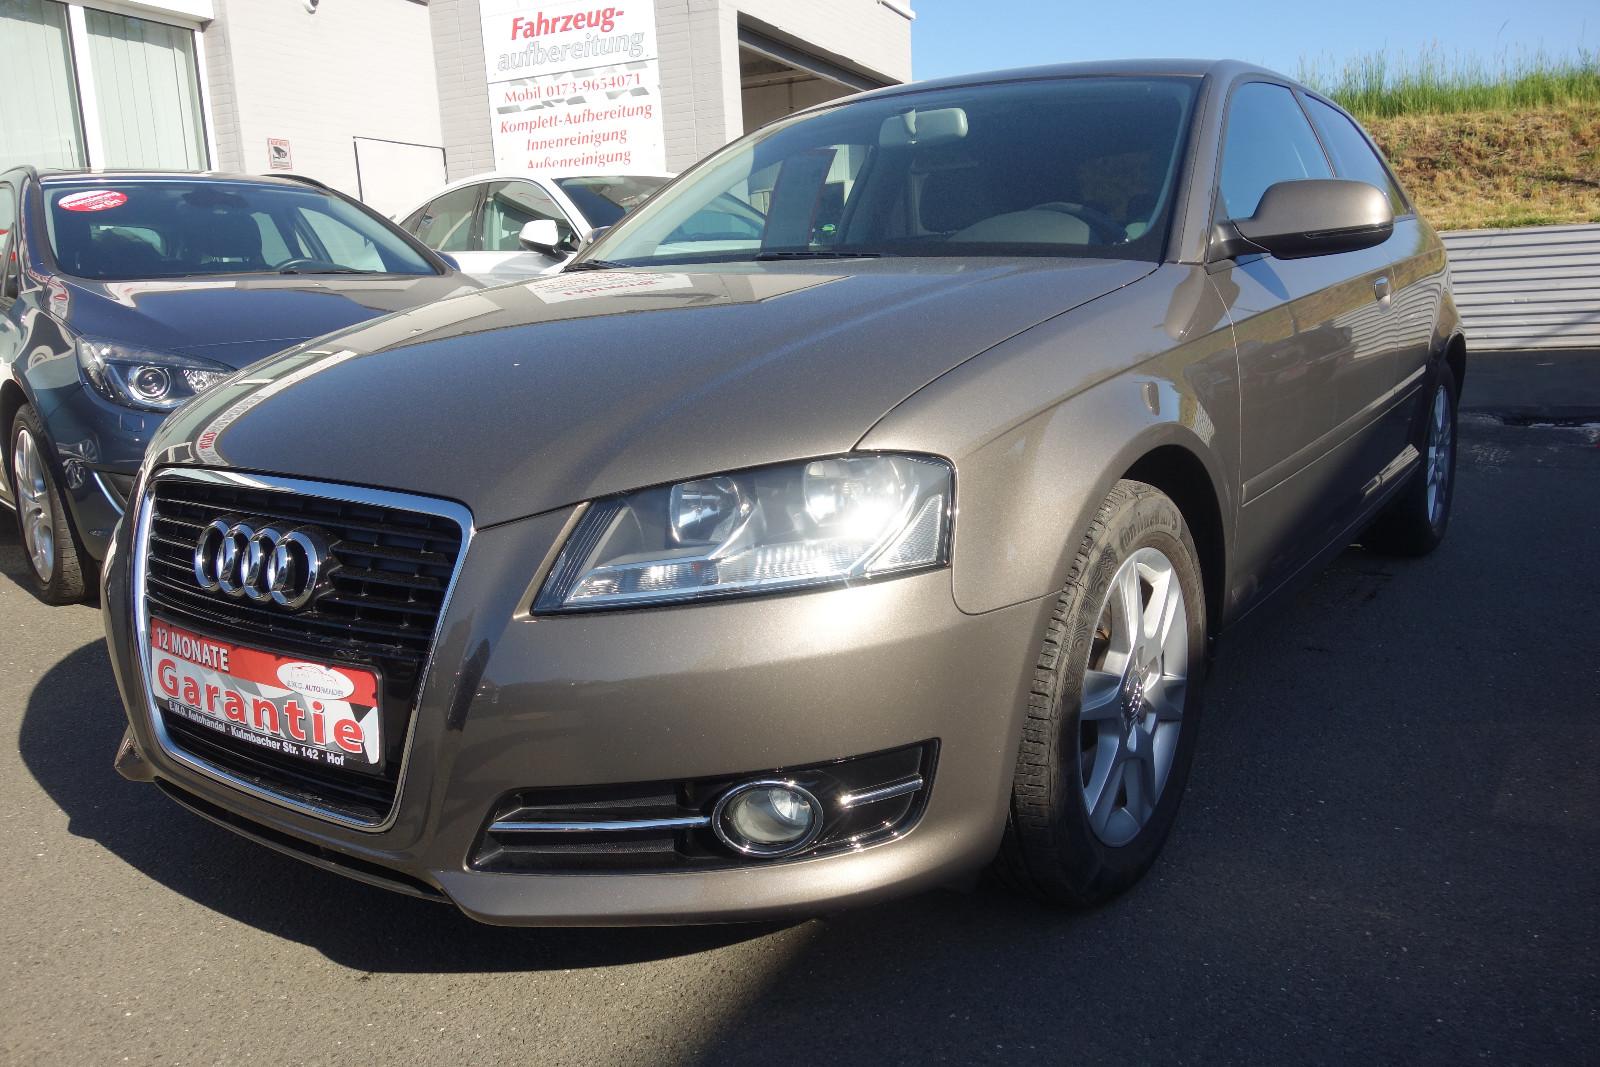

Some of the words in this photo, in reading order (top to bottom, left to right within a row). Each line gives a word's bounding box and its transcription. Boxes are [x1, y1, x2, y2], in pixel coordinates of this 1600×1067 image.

[511, 7, 624, 40] Fahrzeug-
[497, 32, 645, 71] aufbereitung
[504, 86, 541, 104] Mobil
[546, 73, 641, 97] 0173-9654071
[501, 104, 652, 133] Komplett-Aufbereitung
[527, 129, 627, 151] Innenreinigung
[156, 626, 169, 649] 12
[171, 631, 230, 672] MONATE
[157, 658, 366, 753] Garantie
[188, 710, 226, 733] Autohandel
[231, 726, 281, 750] Kulmbacher
[282, 741, 299, 756] Str.
[301, 743, 318, 760] 142
[326, 751, 345, 766] Hof
